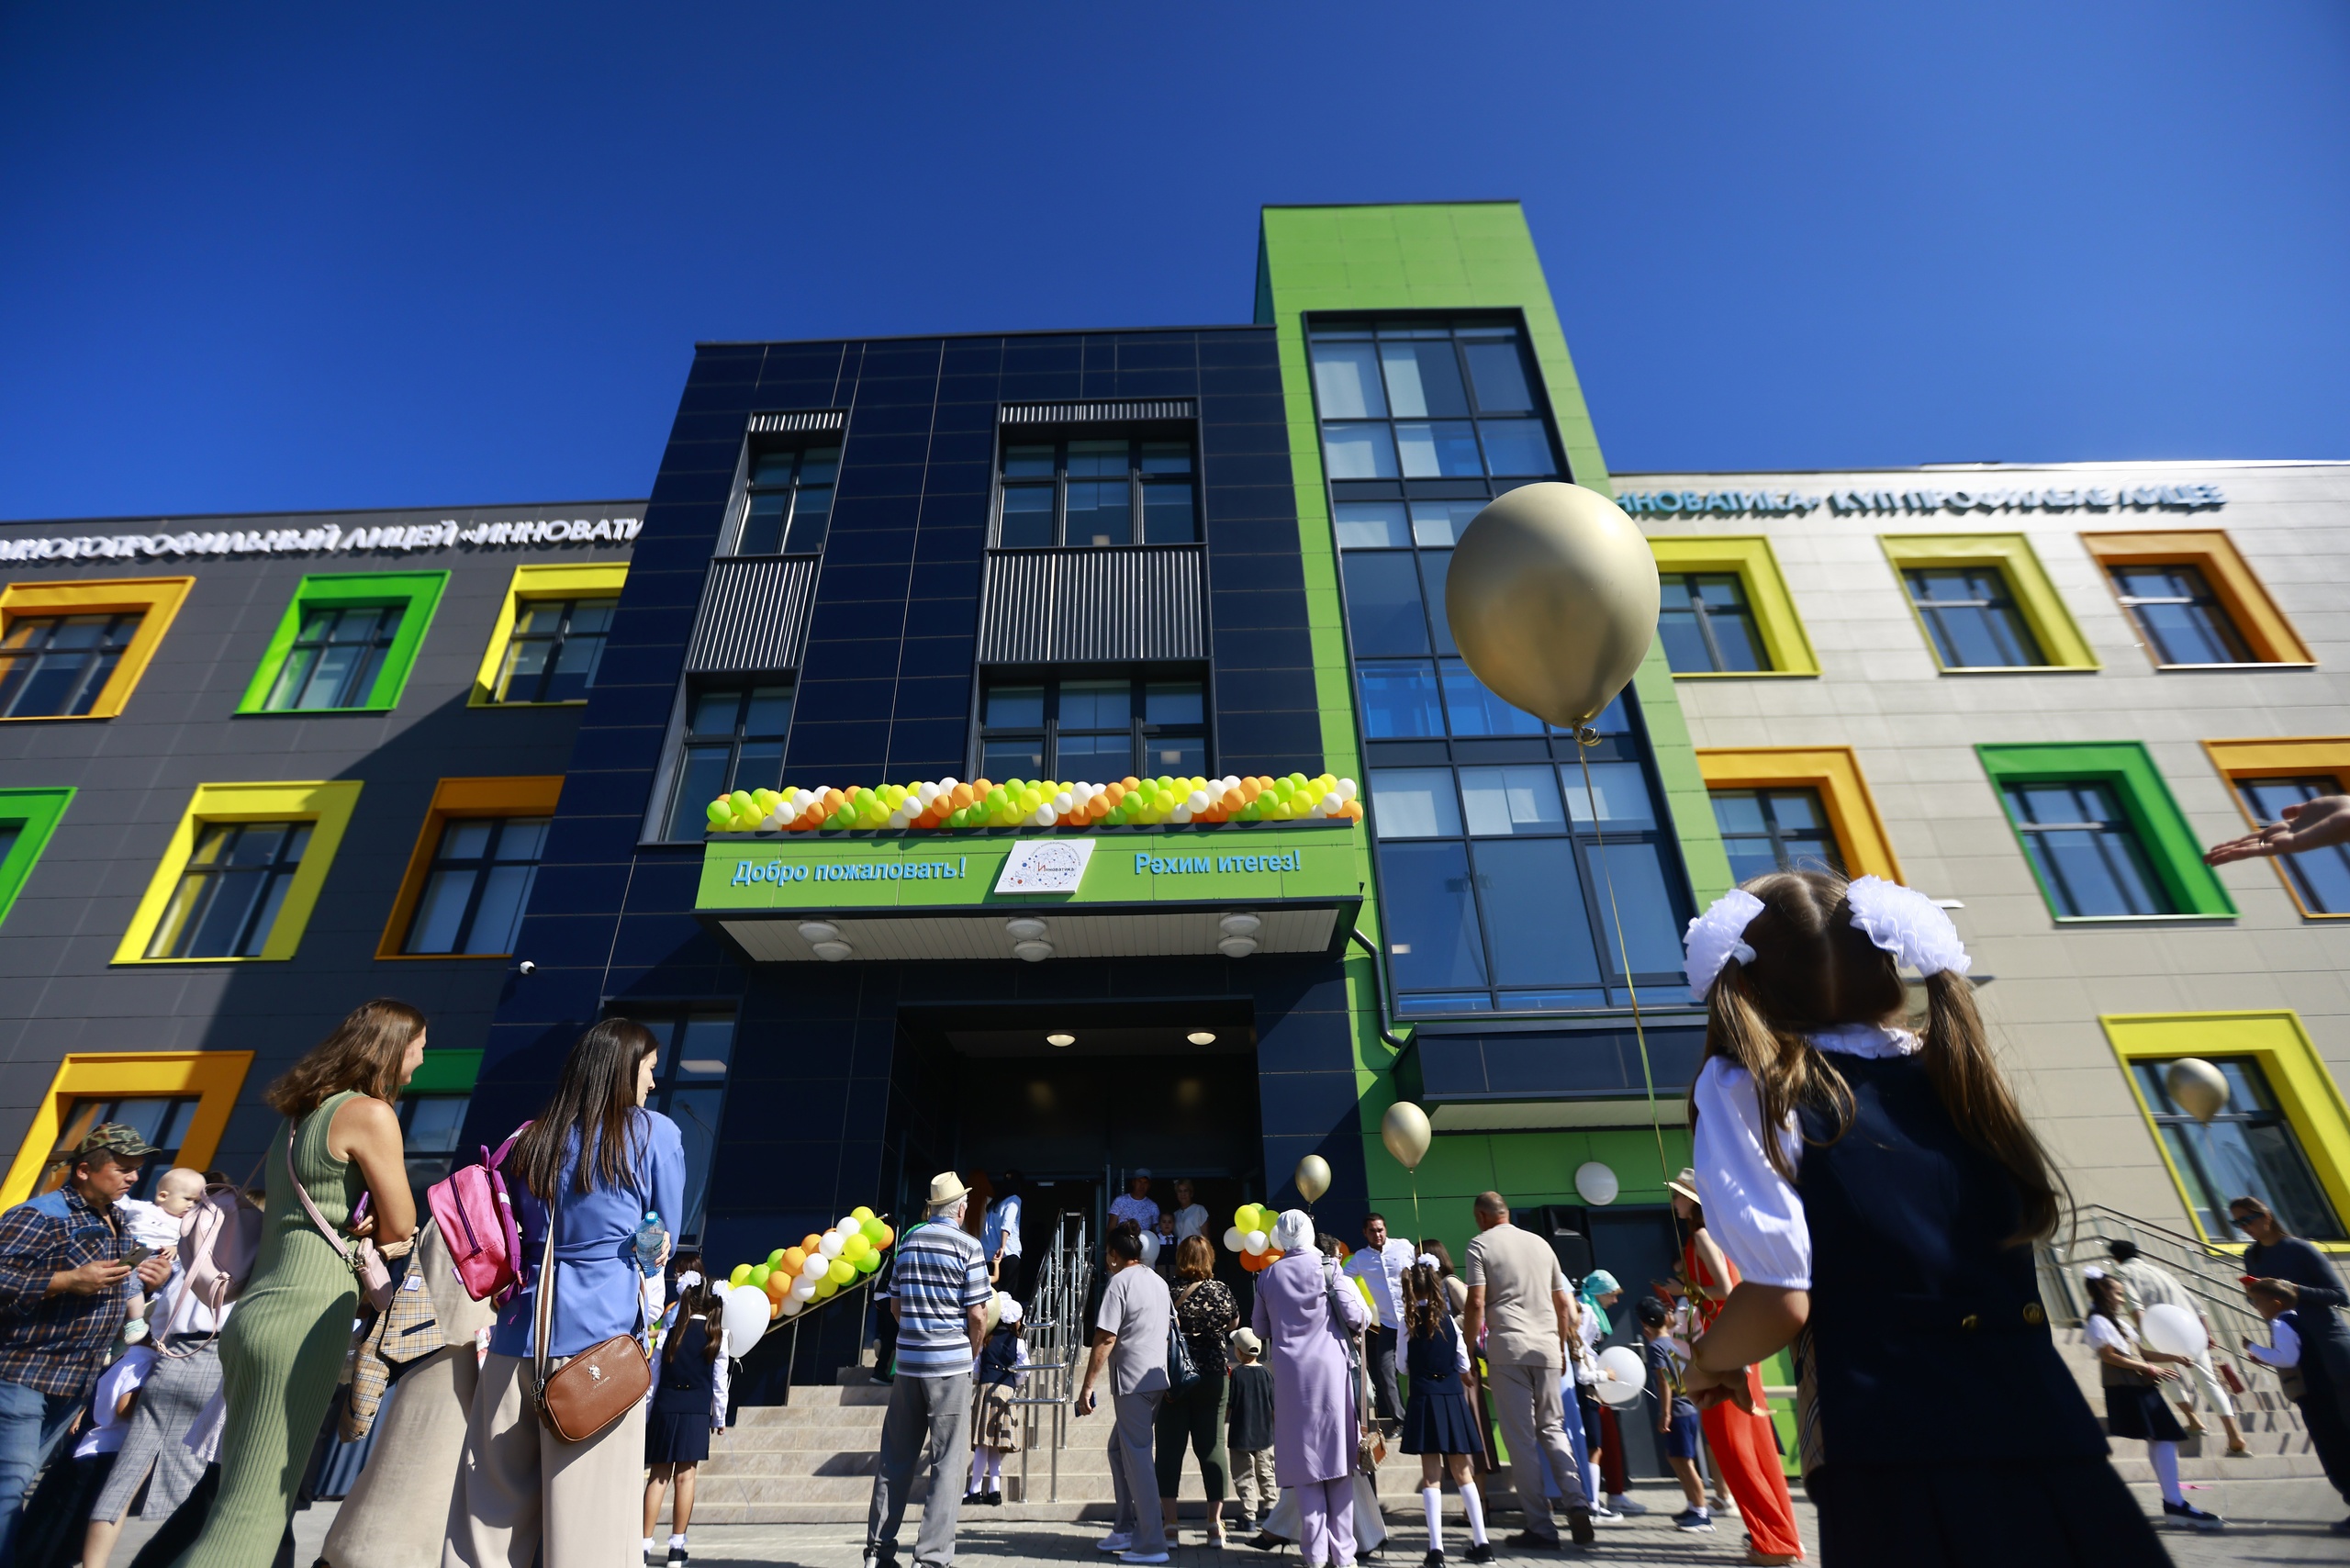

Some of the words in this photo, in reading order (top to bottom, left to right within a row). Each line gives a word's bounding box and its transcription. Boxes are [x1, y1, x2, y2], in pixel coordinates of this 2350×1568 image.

[339, 520, 459, 551] ЛИЦЕЙ
[731, 860, 809, 887] Добро
[813, 857, 967, 881] пожаловать!
[1135, 853, 1211, 874] Рәхим
[1216, 849, 1301, 872] итегез!
